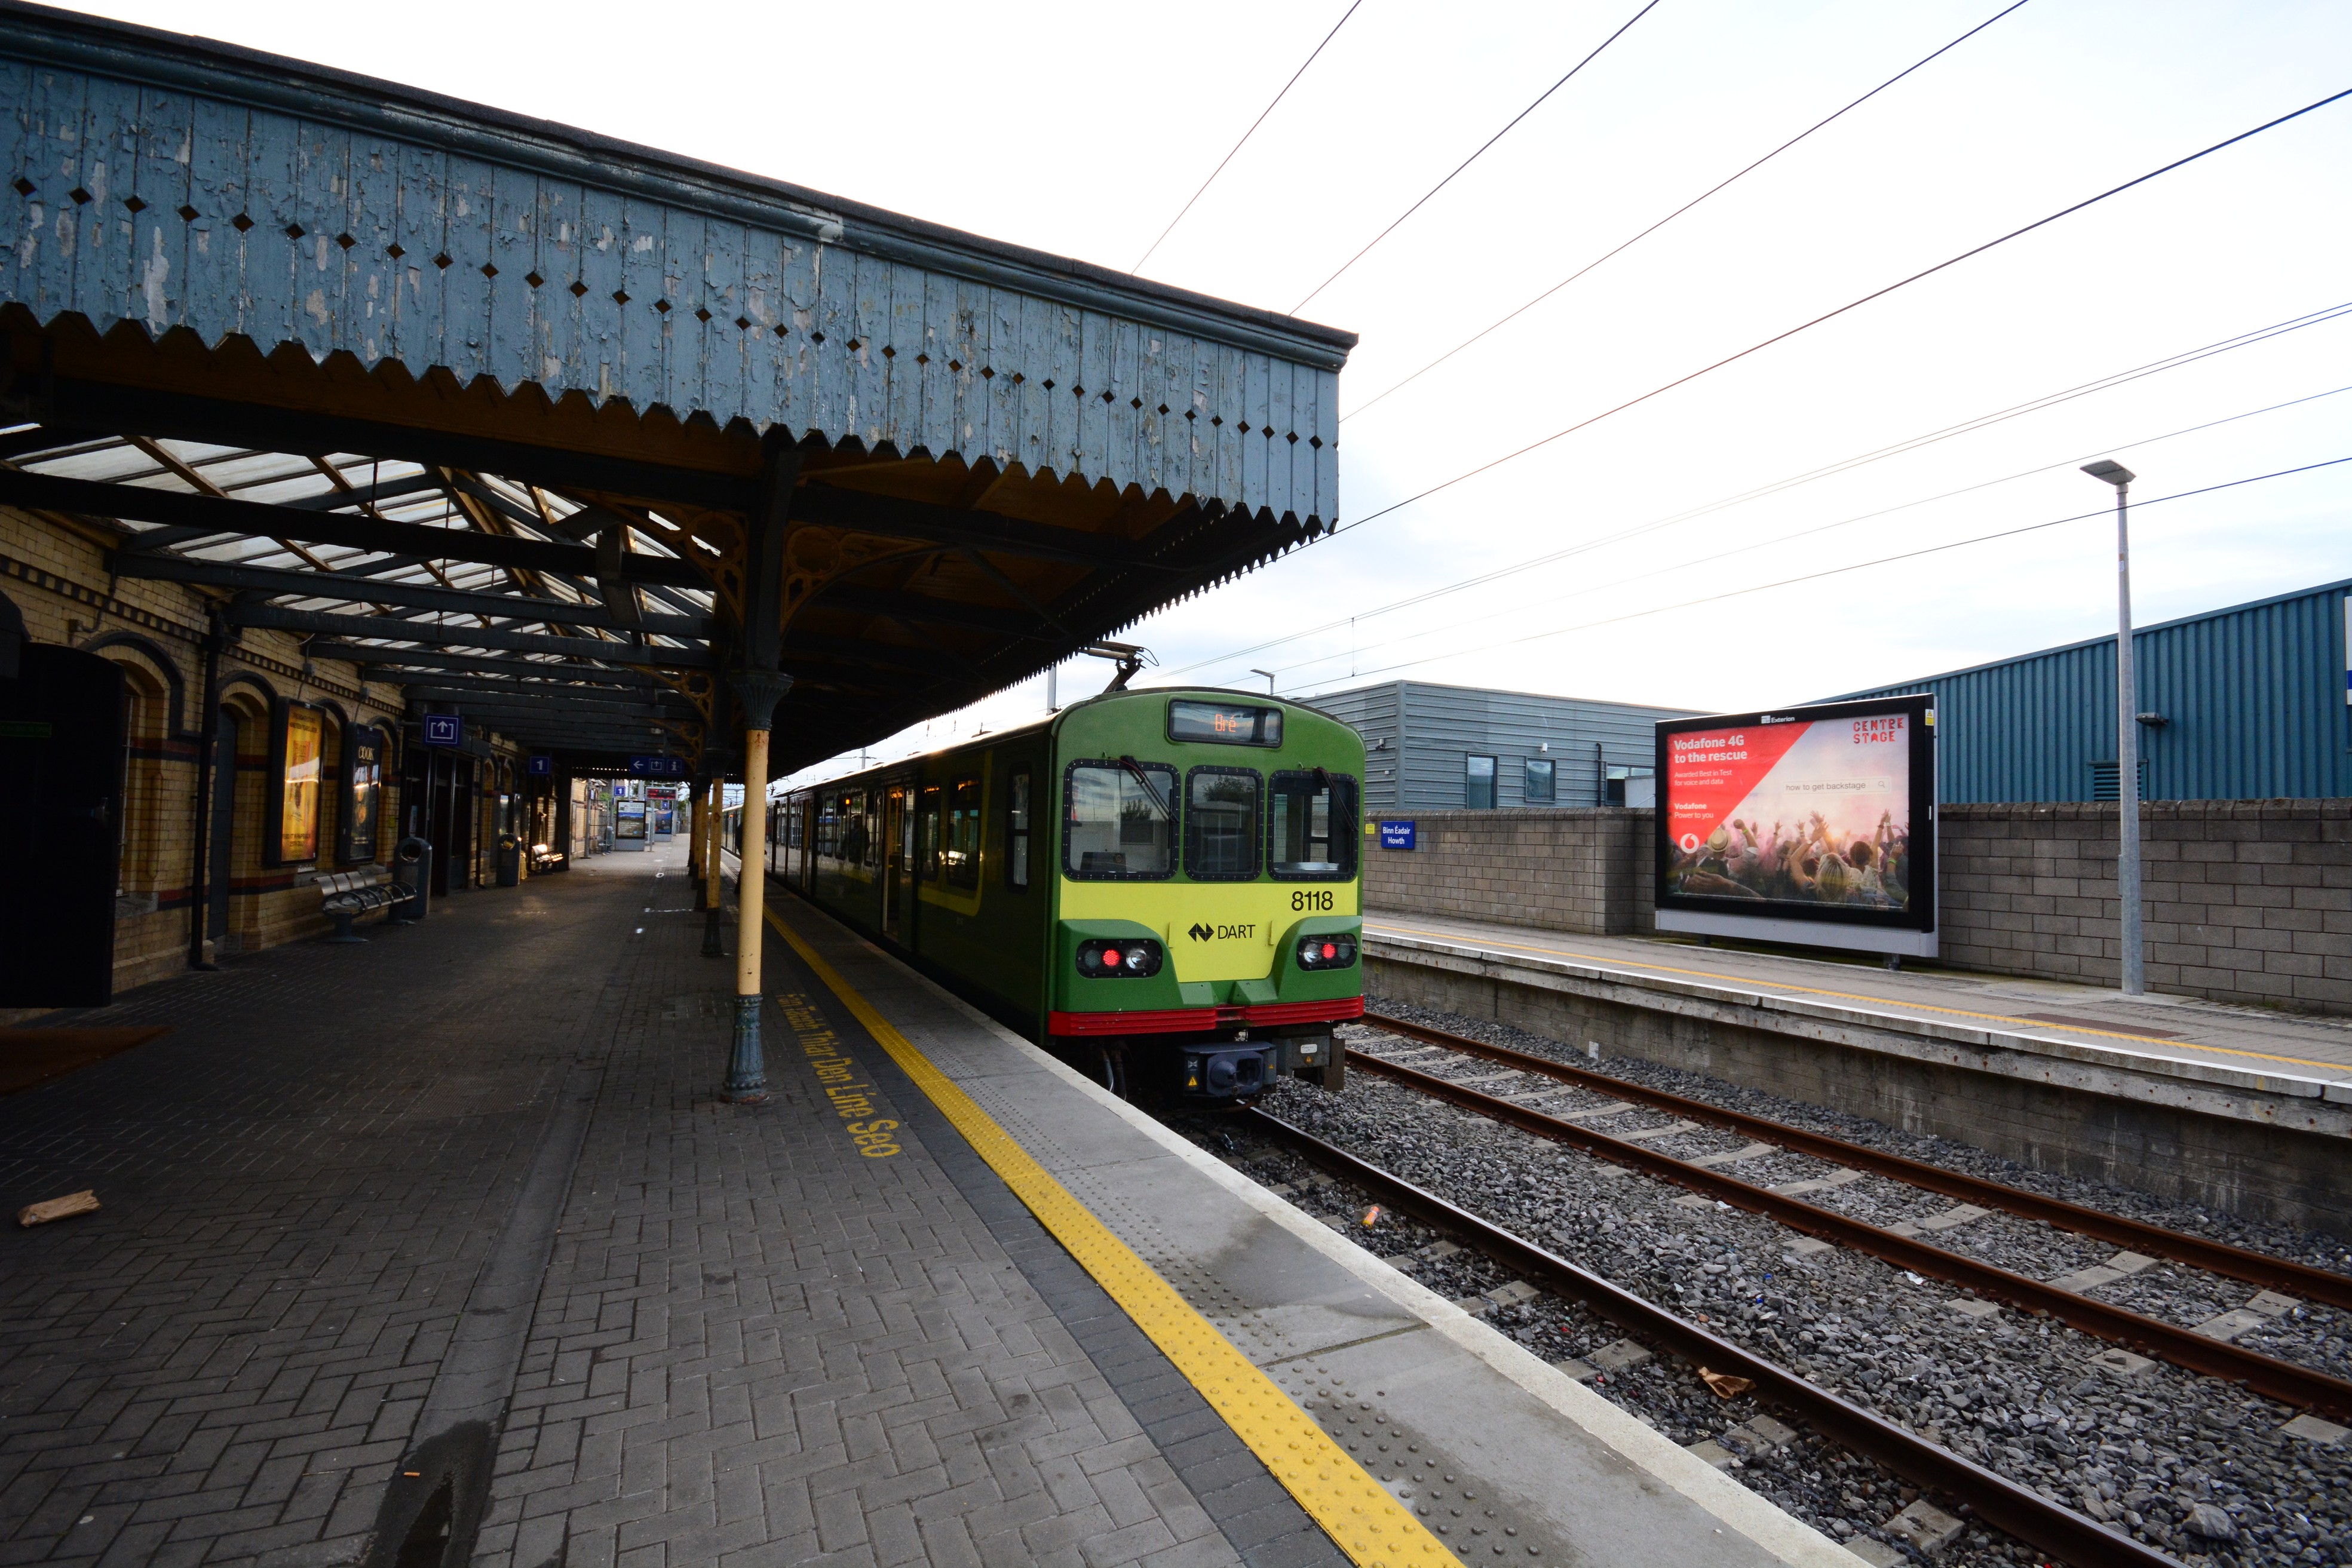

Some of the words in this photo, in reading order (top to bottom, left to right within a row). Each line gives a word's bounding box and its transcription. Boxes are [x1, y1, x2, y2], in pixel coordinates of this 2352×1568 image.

[1215, 714, 1237, 732] Bré
[1853, 717, 1904, 732] CENTRE
[1674, 738, 1725, 750] Vodafone
[1728, 735, 1744, 745] 4G
[1854, 731, 1896, 744] STAGE
[358, 745, 375, 761] COOK
[1675, 754, 1686, 763] to
[1688, 752, 1707, 762] the
[1709, 751, 1747, 762] rescue
[536, 759, 543, 771] 1
[1812, 783, 1824, 791] get
[1826, 781, 1866, 790] backstage
[1394, 826, 1410, 834] Éadair
[1291, 891, 1333, 911] 8118
[1218, 924, 1256, 940] DART
[798, 1030, 840, 1057] Thiar
[811, 1058, 853, 1084] Den
[825, 1084, 877, 1118] Líne
[847, 1119, 901, 1158] Seo
